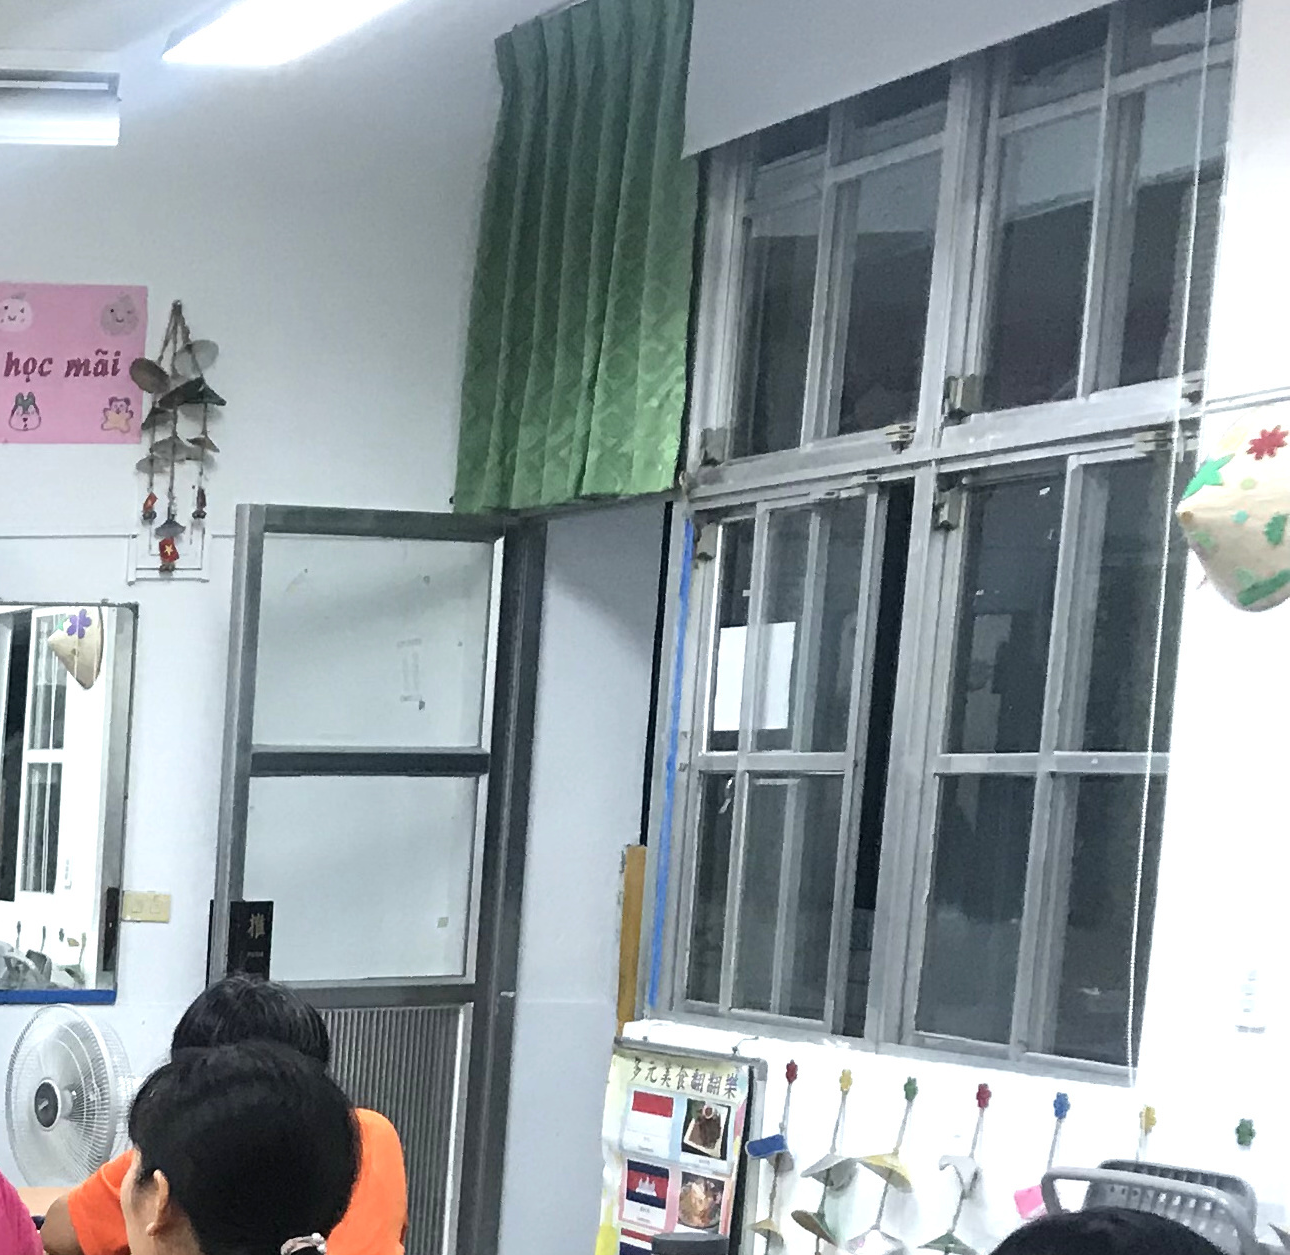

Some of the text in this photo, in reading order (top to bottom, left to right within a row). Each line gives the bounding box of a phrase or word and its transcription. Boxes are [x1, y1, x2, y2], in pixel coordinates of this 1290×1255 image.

[3, 351, 54, 383] học
[64, 348, 123, 379] mãi
[630, 1056, 739, 1099] 多元美食翻翻樂
